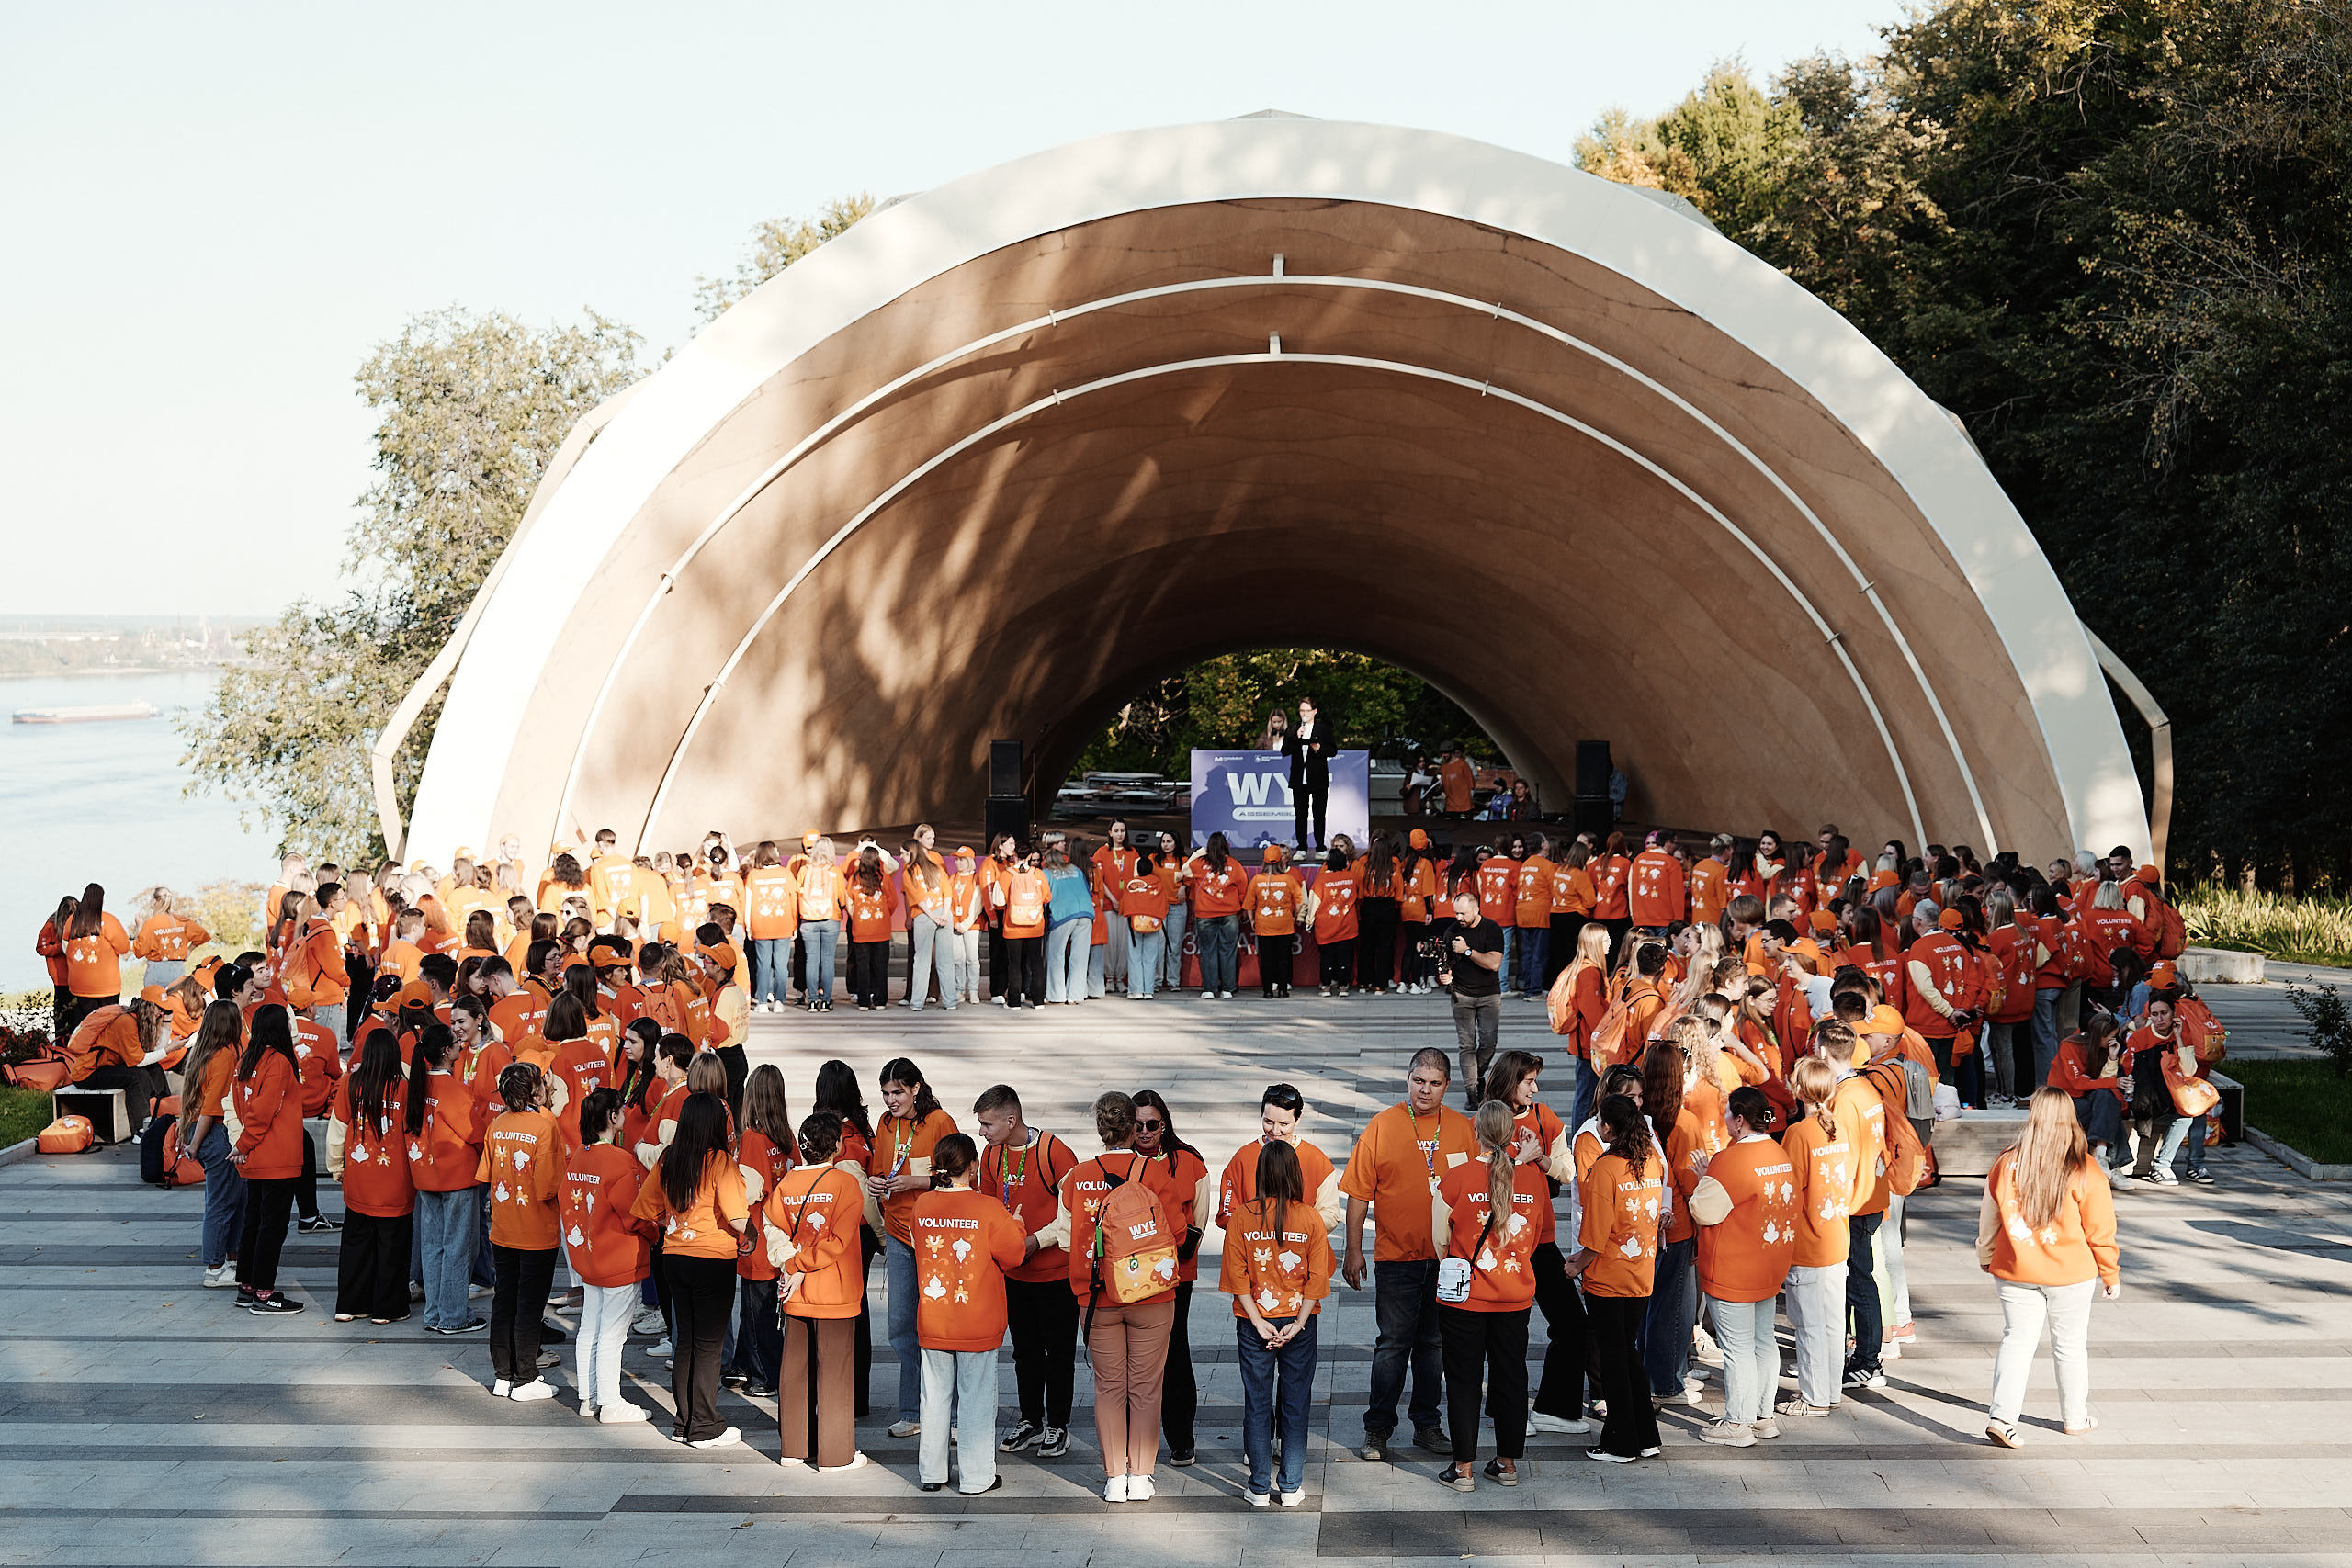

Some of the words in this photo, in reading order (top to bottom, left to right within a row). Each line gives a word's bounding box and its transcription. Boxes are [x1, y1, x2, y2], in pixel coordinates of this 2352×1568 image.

[492, 1131, 537, 1145] VOLUNTEER
[1468, 1193, 1534, 1205] VOLEER
[918, 1217, 979, 1230] VOLUNTEER
[1128, 1220, 1157, 1236] WYF
[1244, 1231, 1308, 1244] VOLUTEER
